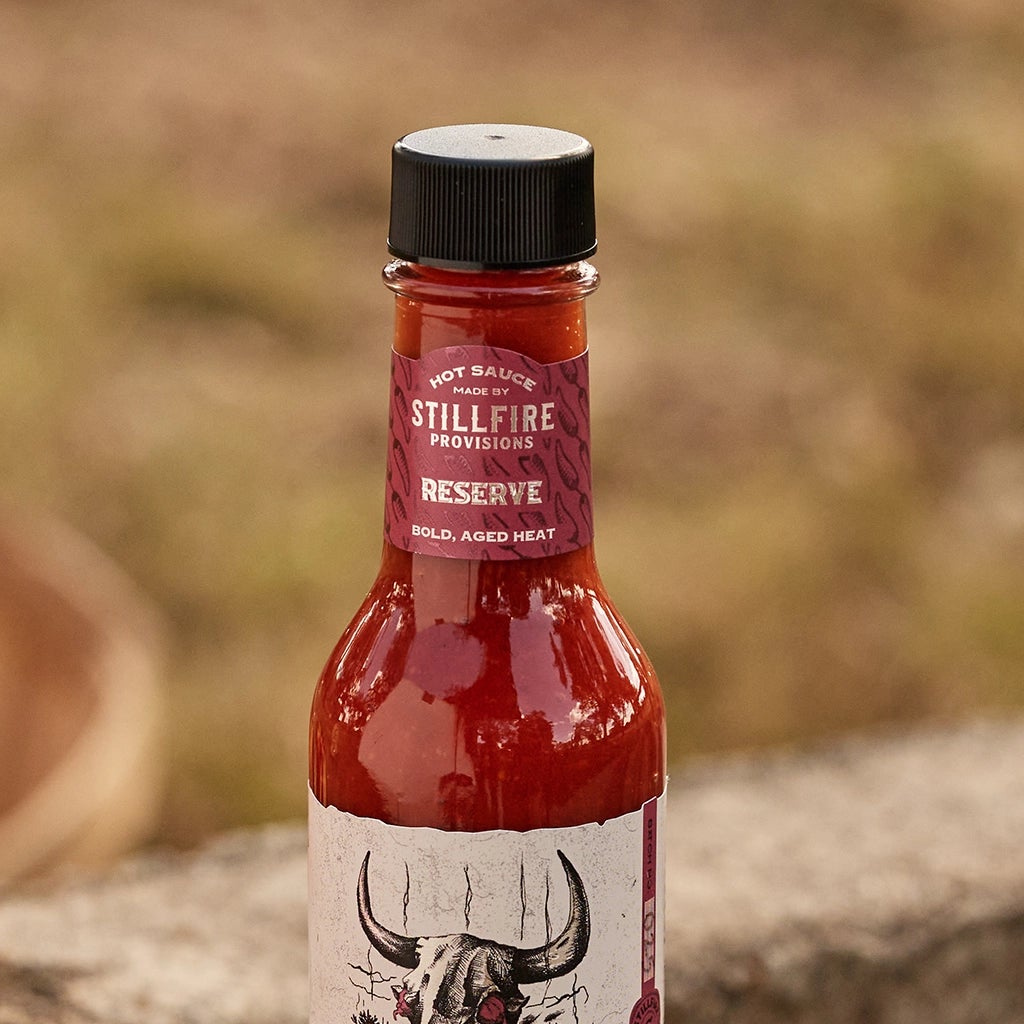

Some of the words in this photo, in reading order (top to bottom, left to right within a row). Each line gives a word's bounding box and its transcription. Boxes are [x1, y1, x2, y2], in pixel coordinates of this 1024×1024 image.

[429, 366, 466, 389] HOT
[471, 365, 537, 392] SAUCE
[453, 386, 489, 396] MADE
[492, 387, 510, 396] BY
[411, 399, 555, 433] STILLFIRE
[430, 433, 534, 450] PROVISIONS
[421, 476, 543, 506] RESERVE
[412, 524, 456, 542] BOLD,
[460, 531, 509, 543] AGED
[513, 527, 556, 542] HEAT
